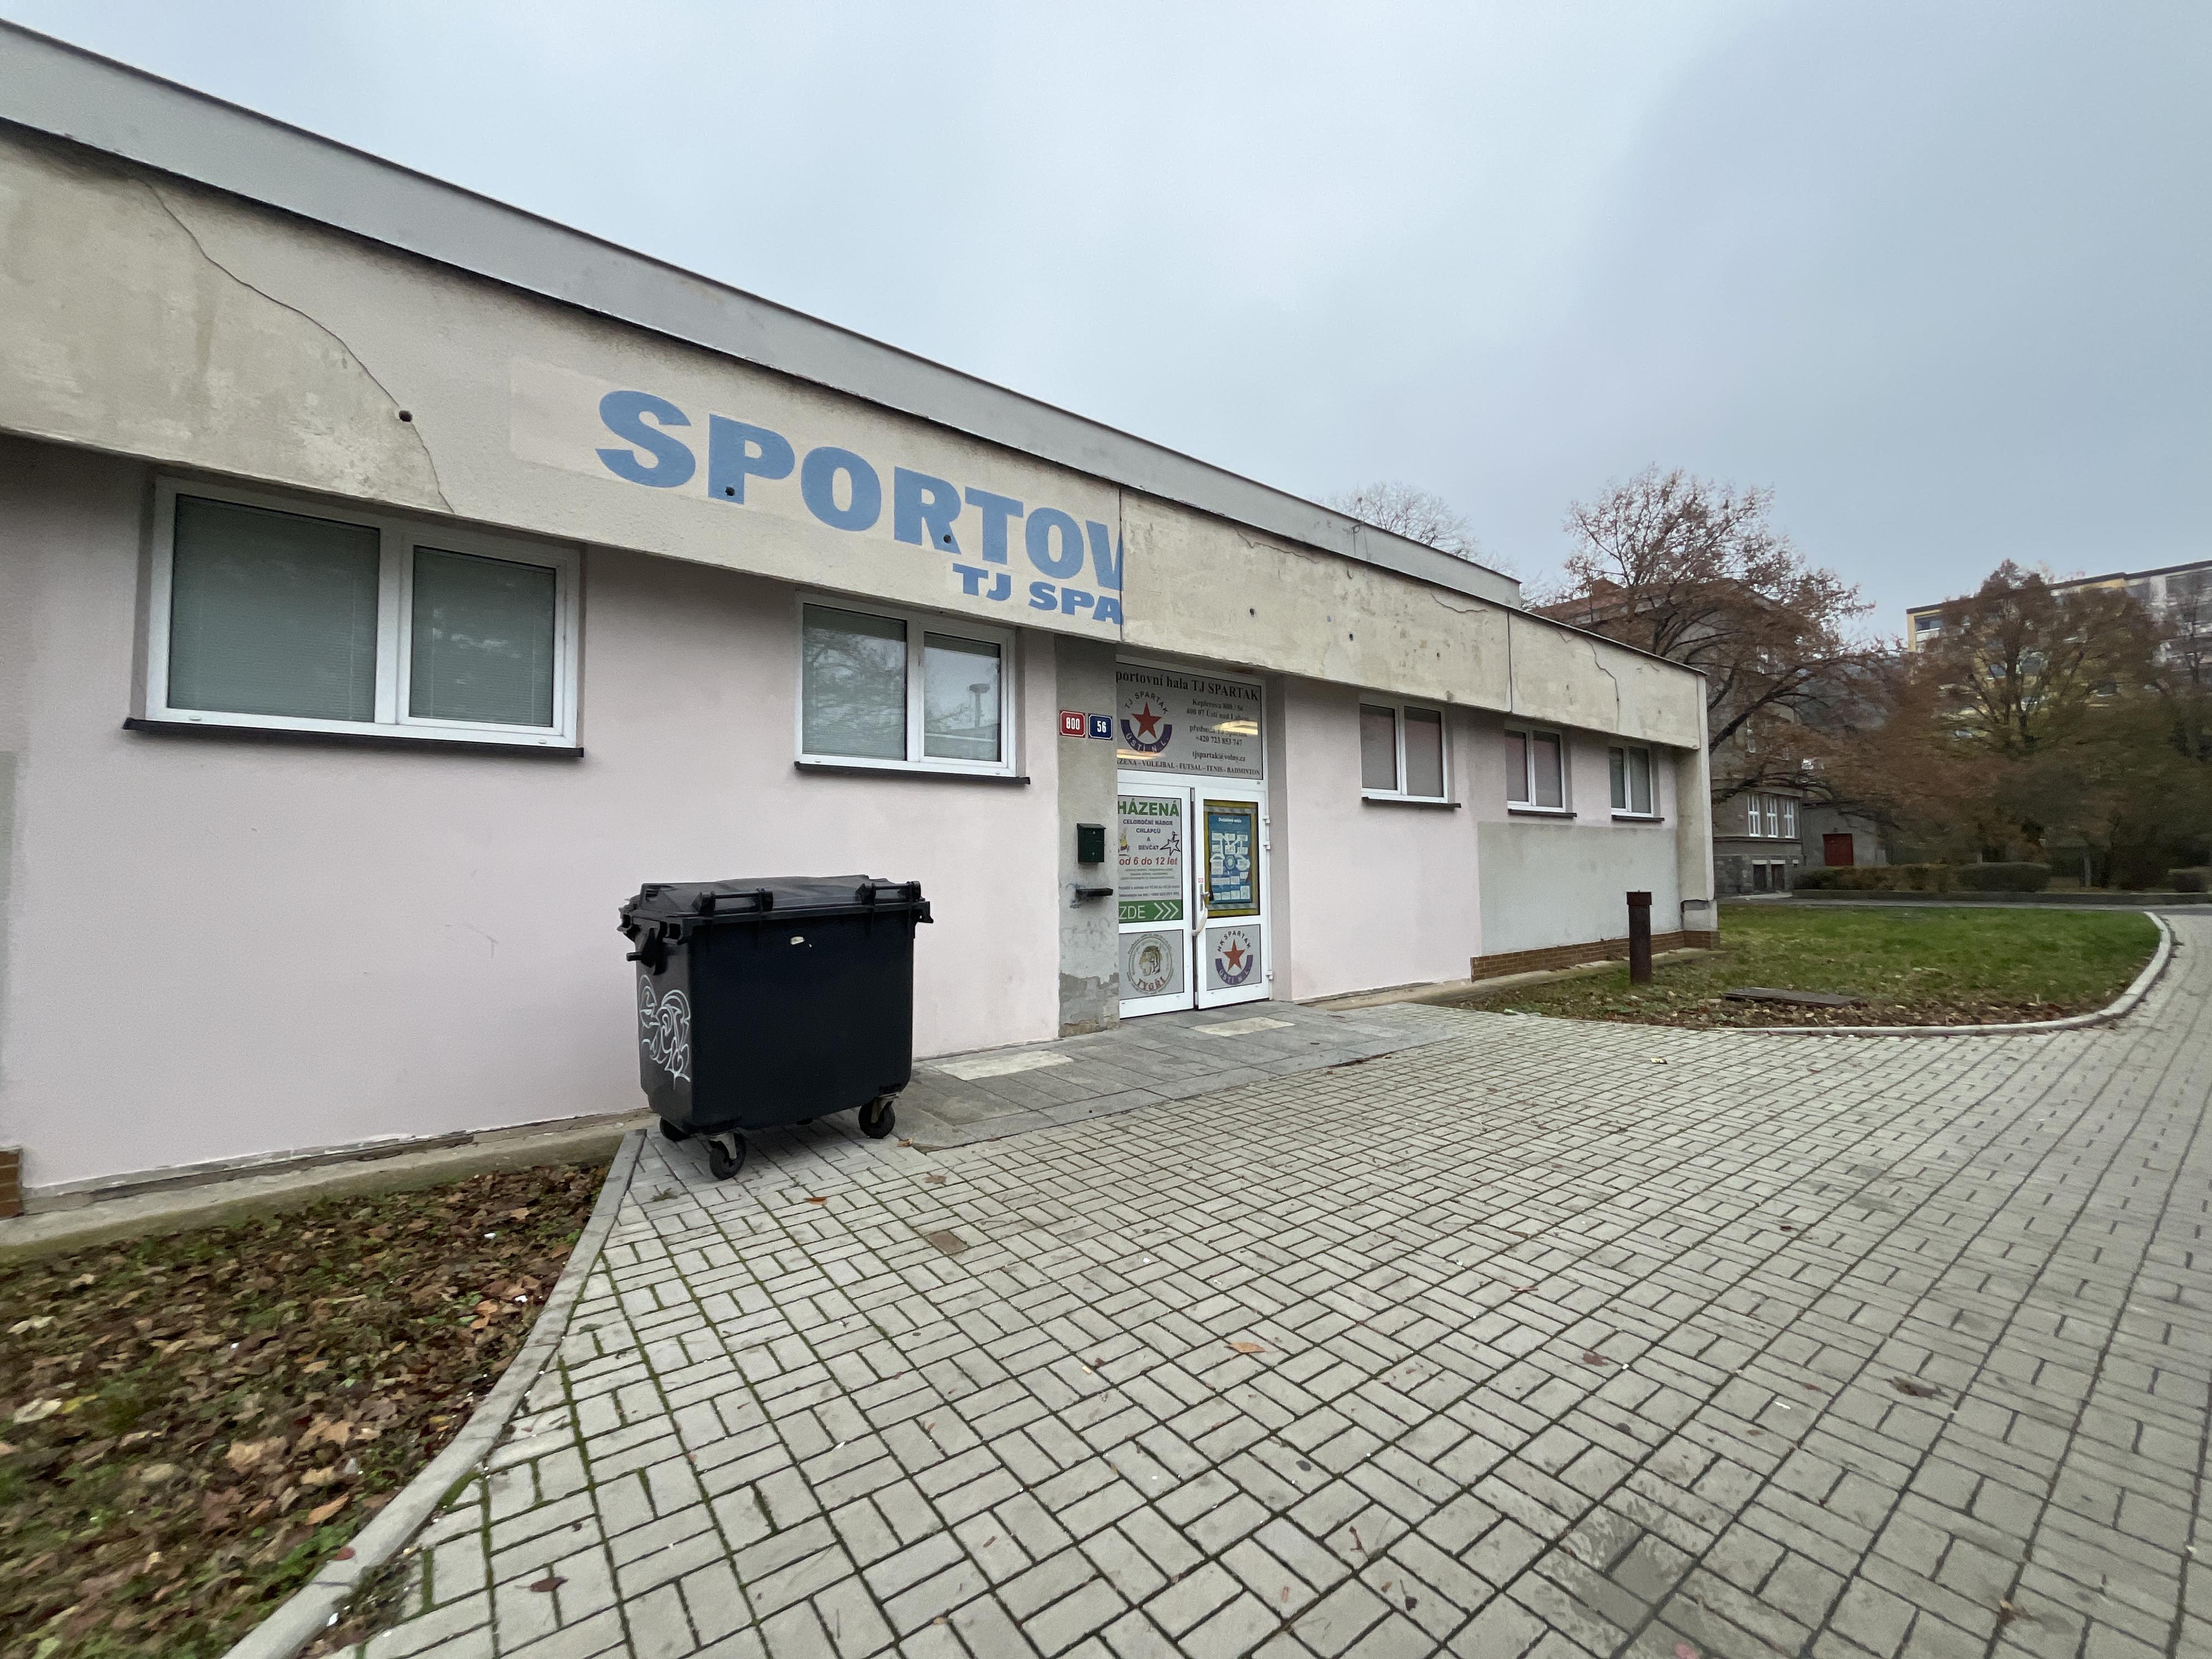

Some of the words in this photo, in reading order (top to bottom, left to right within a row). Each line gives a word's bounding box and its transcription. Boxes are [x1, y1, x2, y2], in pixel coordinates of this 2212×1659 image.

[595, 390, 1123, 591] SPORTOV
[952, 563, 1011, 601] TJ
[1029, 581, 1123, 624] SPA
[1167, 676, 1188, 690] hala
[1191, 680, 1204, 692] TJ
[1208, 682, 1258, 701] SPARTAK
[1125, 698, 1133, 708] TJ
[1135, 691, 1168, 715] SPARTAK
[1066, 717, 1081, 731] 800
[1097, 721, 1107, 733] 56
[1142, 760, 1175, 769] VOLEJBAL
[1227, 767, 1260, 775] BADMINTON
[1118, 798, 1180, 817] HÁZENÁ
[1119, 857, 1131, 865] od
[1133, 856, 1139, 865] 6
[1141, 857, 1152, 865] do
[1156, 857, 1165, 865] 12
[1167, 856, 1178, 865] let
[1119, 905, 1146, 920] ZDE
[1224, 930, 1251, 949] SPARTAK
[1137, 976, 1166, 991] TYGŘI
